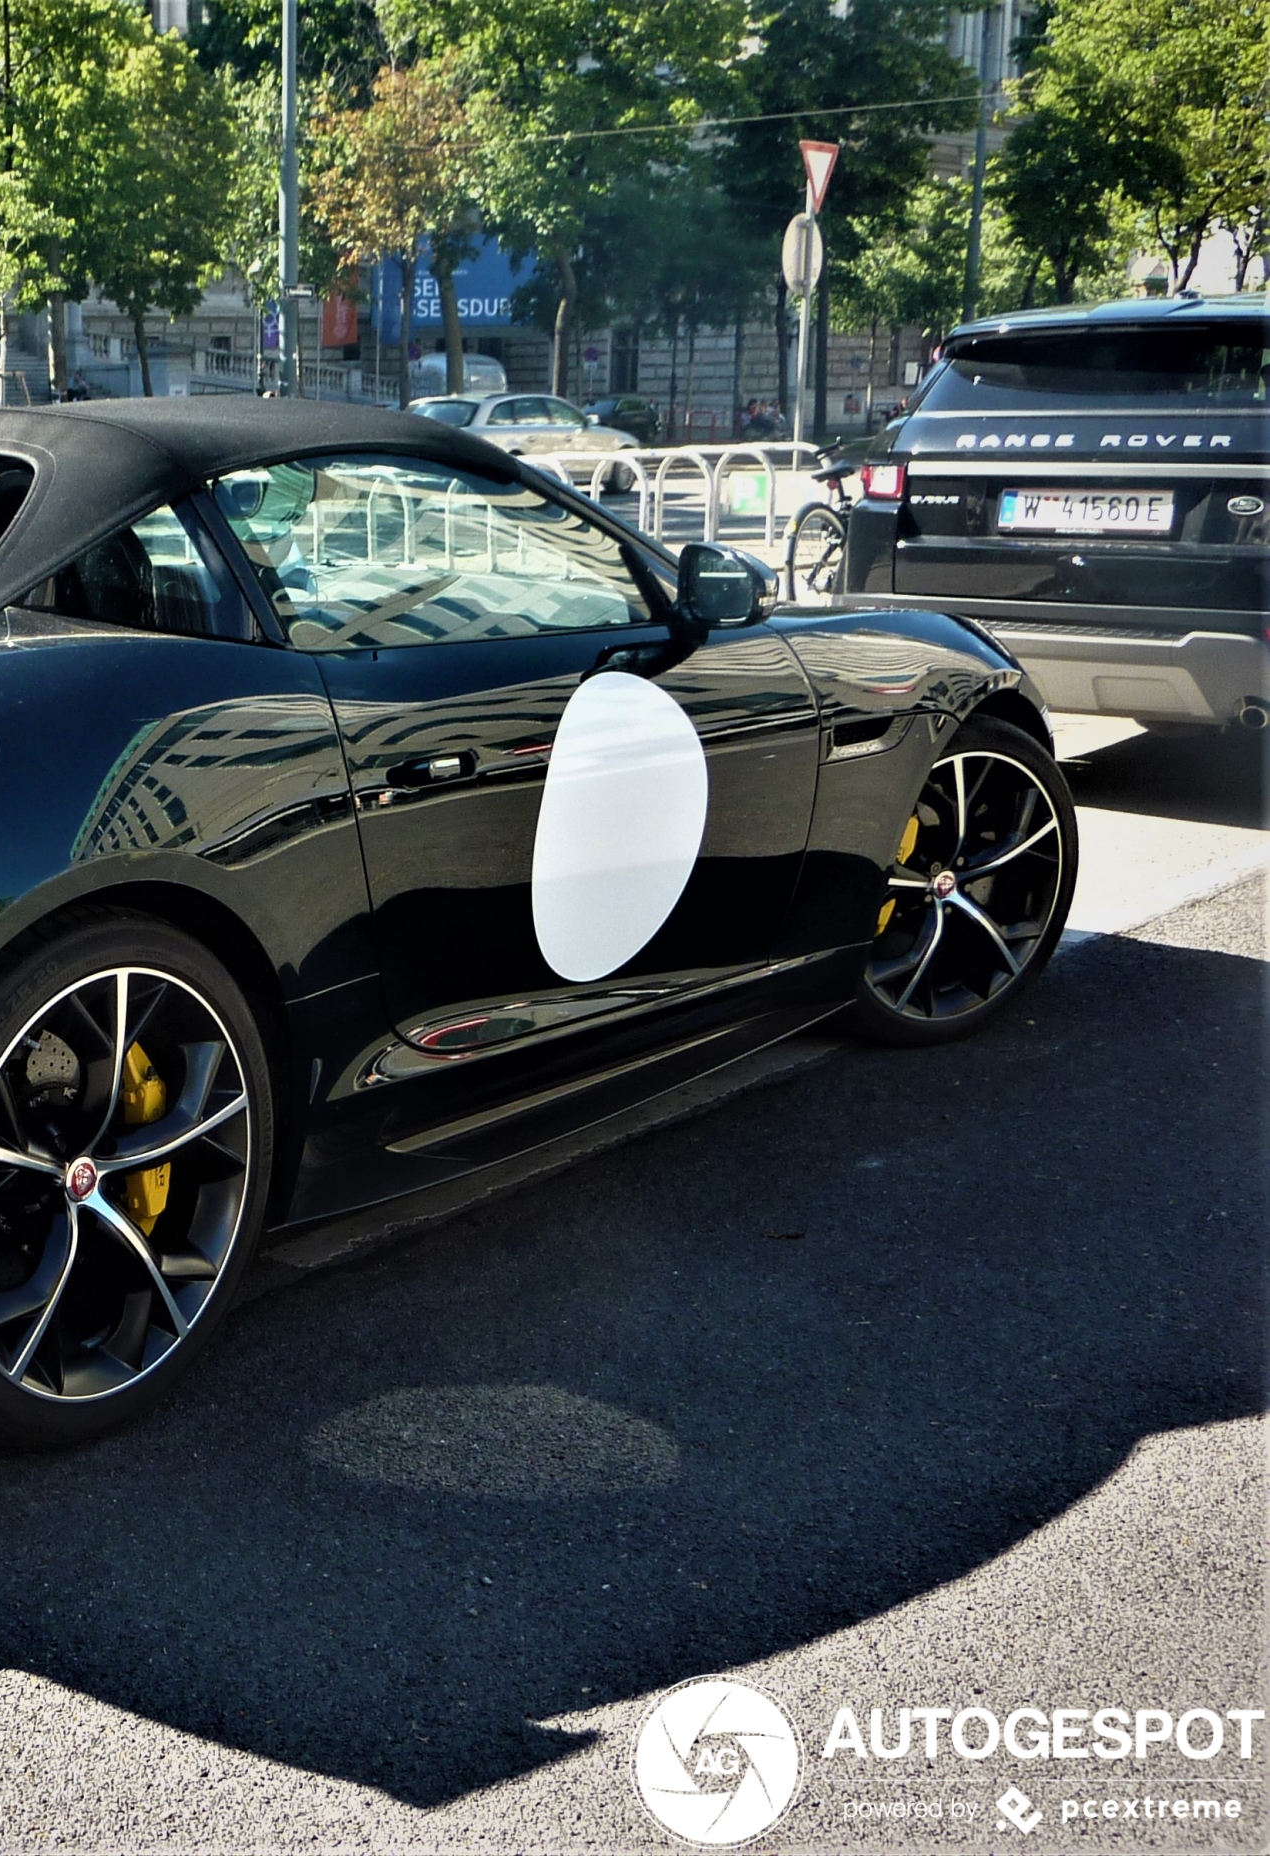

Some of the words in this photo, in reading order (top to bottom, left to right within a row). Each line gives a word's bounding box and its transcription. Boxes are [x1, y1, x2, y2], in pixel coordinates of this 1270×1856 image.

[955, 434, 1076, 449] RANGE
[1100, 434, 1232, 448] ROVER
[1024, 495, 1041, 519] W
[1062, 496, 1140, 522] 41560
[1147, 497, 1163, 522] E
